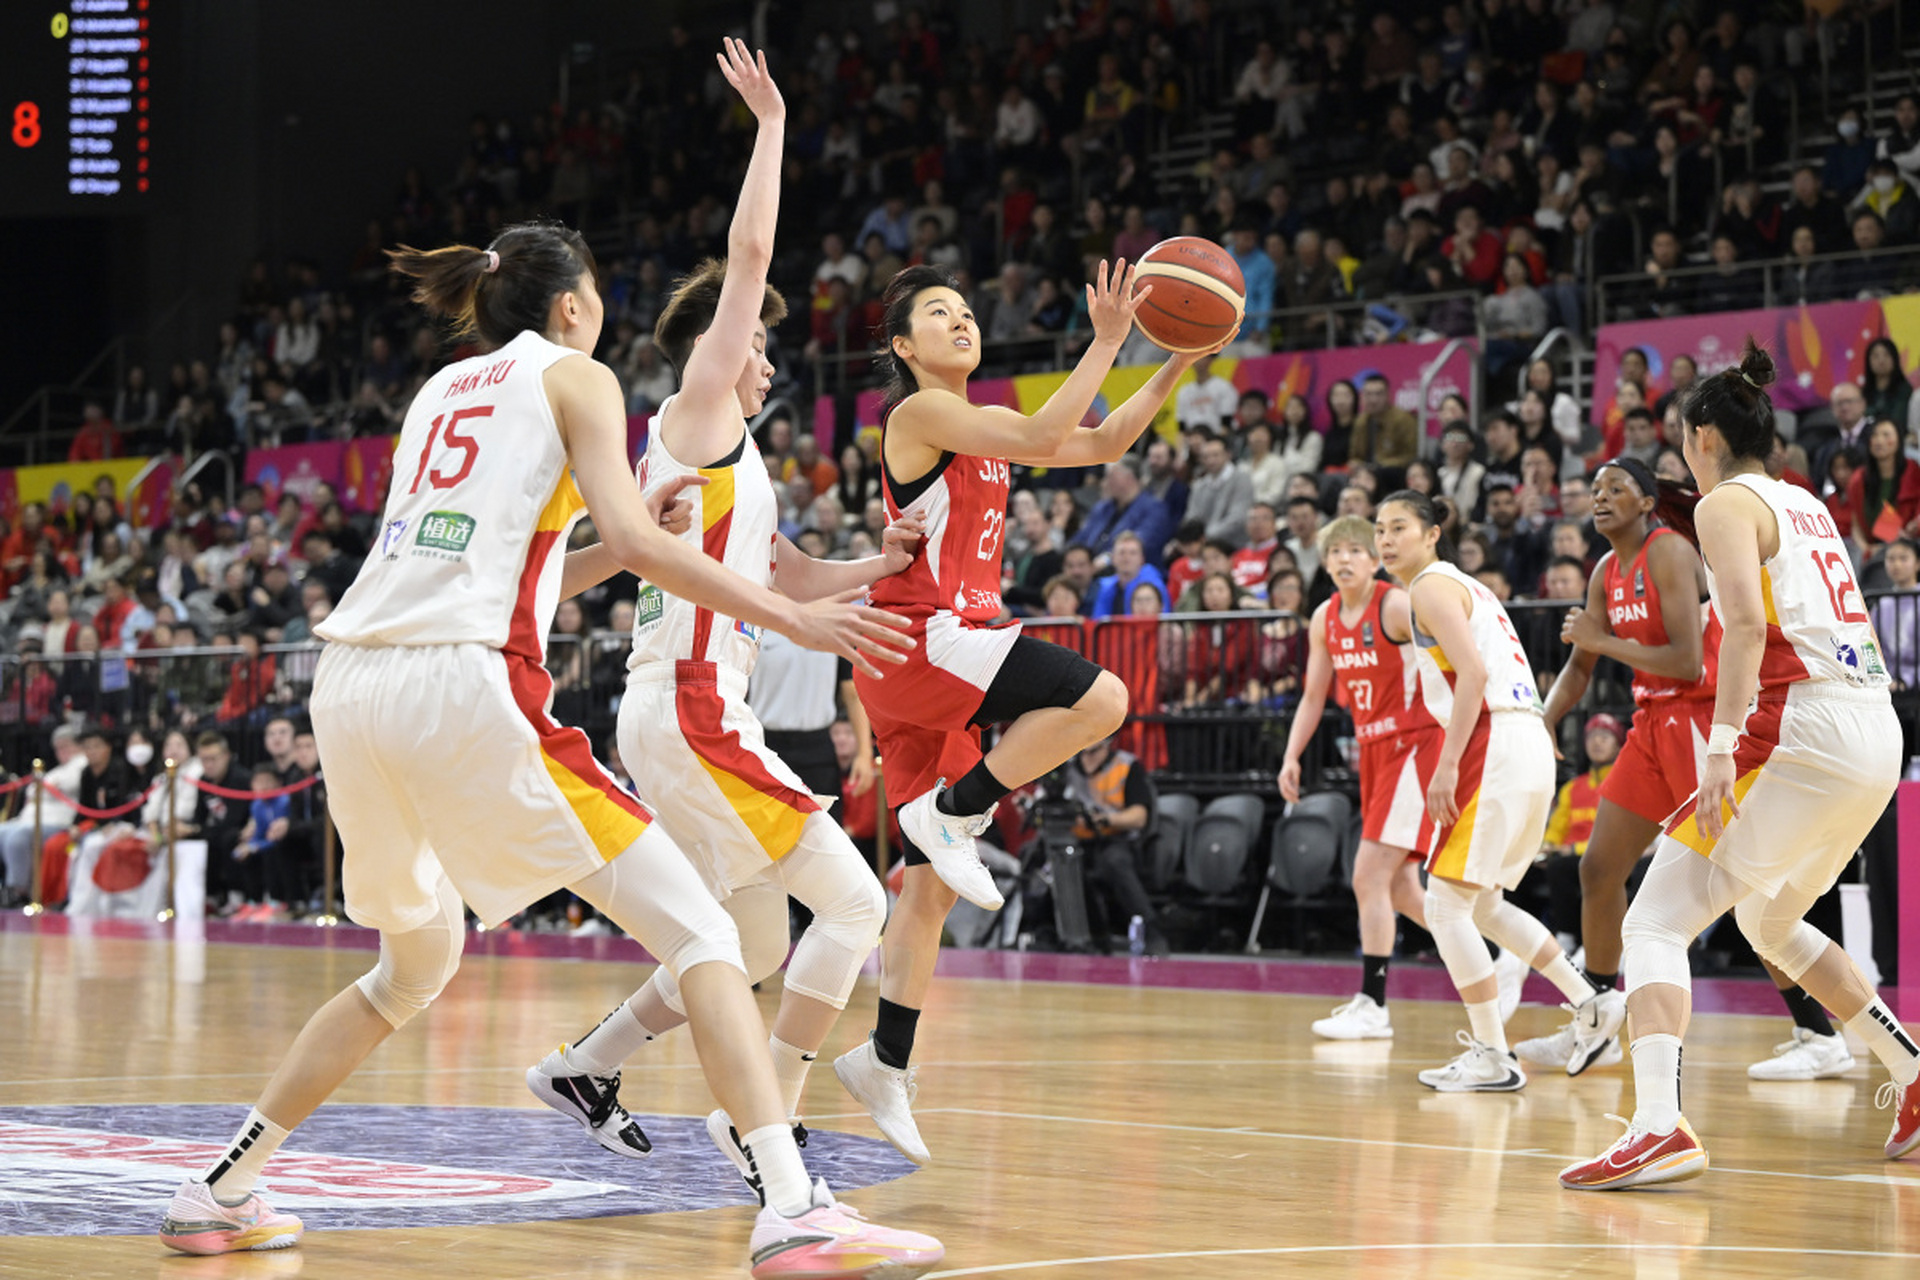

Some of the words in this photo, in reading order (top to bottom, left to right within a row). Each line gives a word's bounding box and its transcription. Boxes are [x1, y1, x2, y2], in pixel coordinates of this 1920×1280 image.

[12, 101, 41, 148] 8
[444, 371, 483, 400] HAN
[481, 359, 517, 388] XU
[408, 405, 495, 495] 15
[979, 457, 1010, 489] JAP
[422, 516, 471, 544] 植选
[977, 508, 1003, 562] 23
[1811, 550, 1868, 623] 12
[1347, 679, 1372, 711] 27
